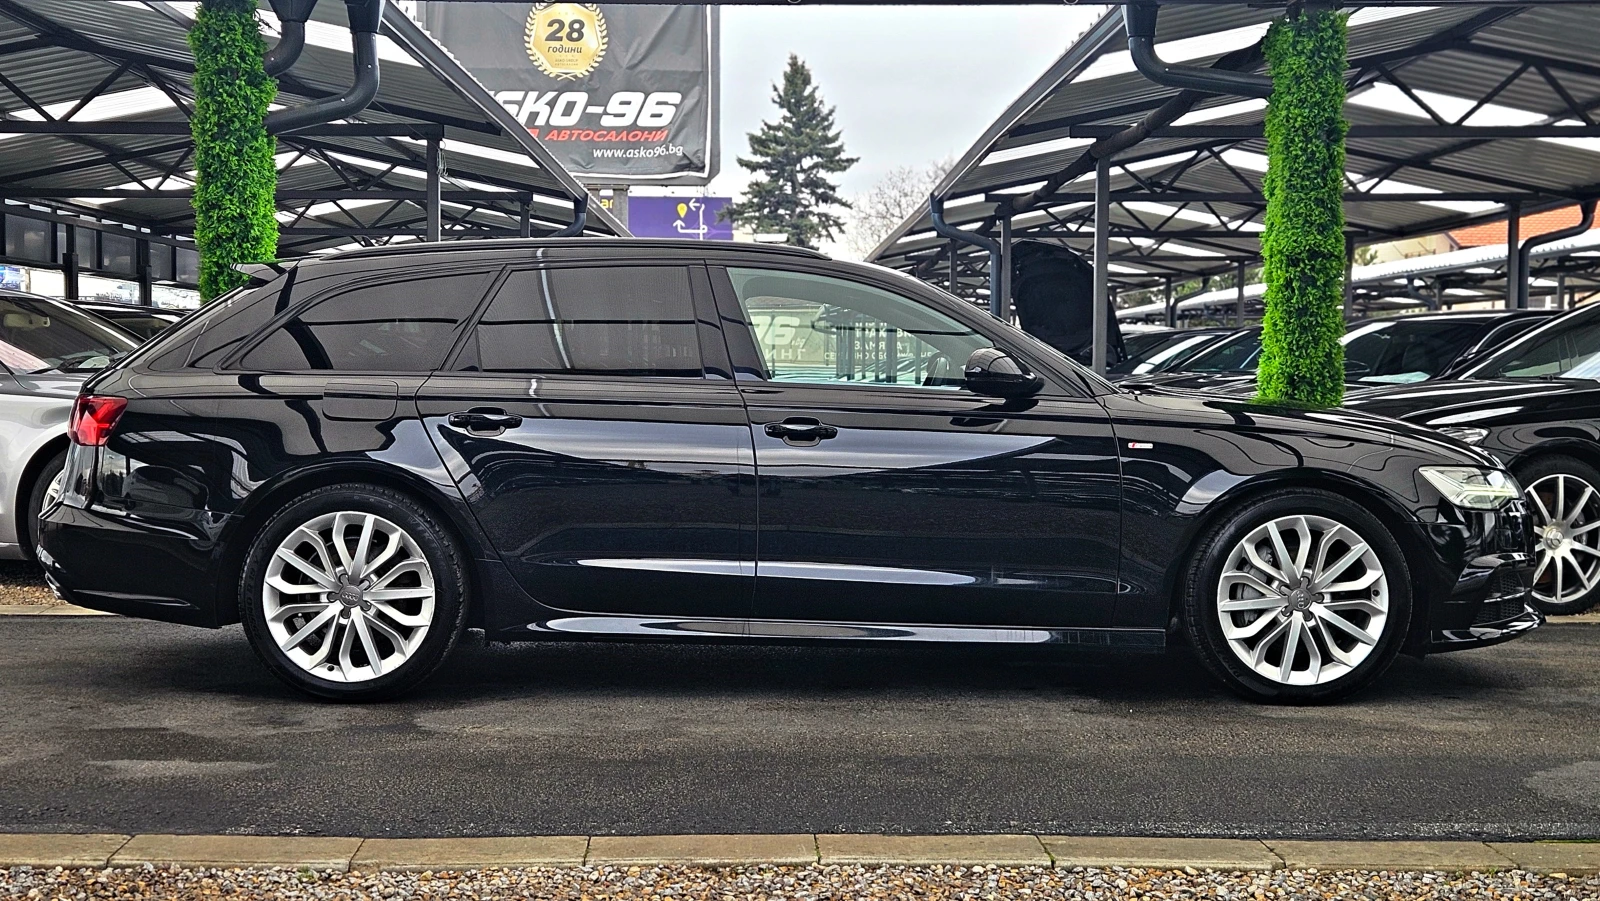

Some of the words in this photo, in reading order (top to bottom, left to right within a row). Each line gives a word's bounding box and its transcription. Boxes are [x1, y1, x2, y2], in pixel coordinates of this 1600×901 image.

[545, 19, 585, 42] 28
[547, 44, 582, 54] години
[489, 91, 682, 127] SKO-96
[544, 129, 668, 142] АВТОСАЛОНИ
[593, 143, 683, 158] www.asko96.bg
